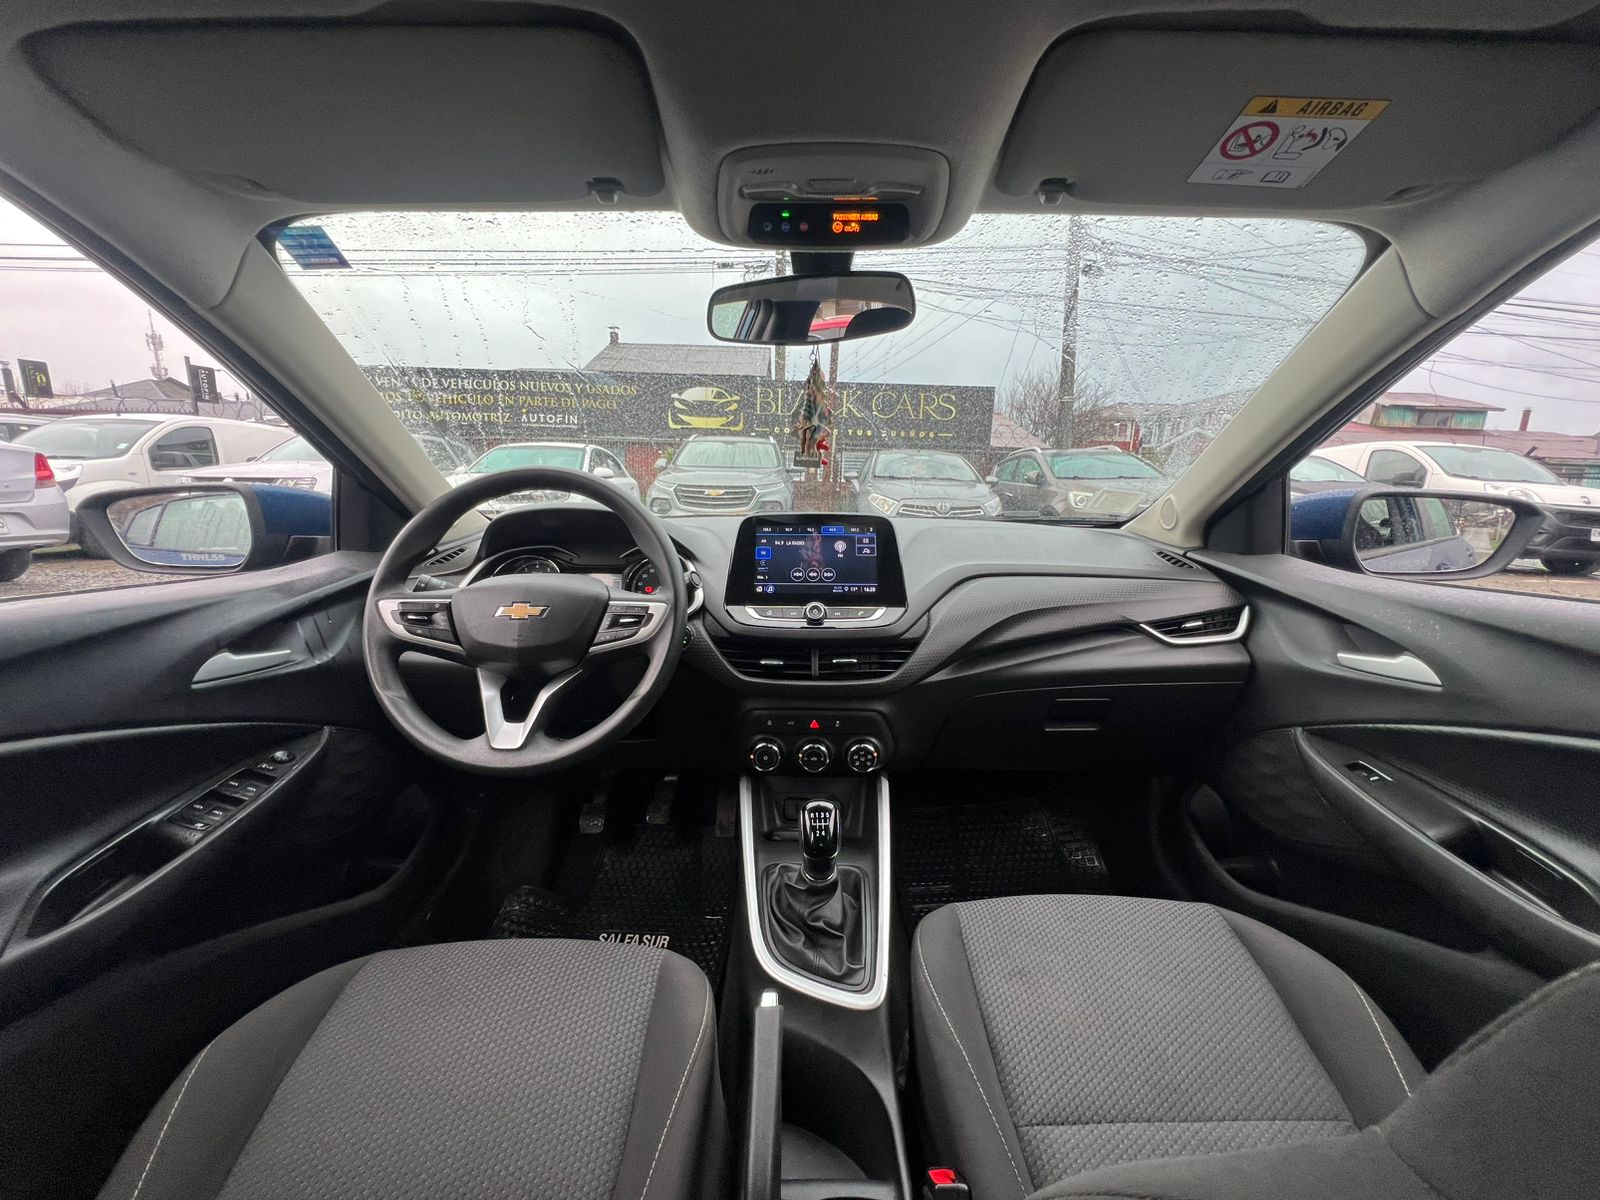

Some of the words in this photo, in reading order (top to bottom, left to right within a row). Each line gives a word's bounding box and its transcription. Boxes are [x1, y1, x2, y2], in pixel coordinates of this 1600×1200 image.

[1296, 100, 1369, 117] AIRBAG
[520, 381, 572, 394] NUEVOS
[575, 384, 584, 394] Y
[586, 384, 637, 396] USADOS
[519, 396, 558, 409] PARTE
[582, 399, 618, 410] PAGO
[754, 386, 863, 417] BLK
[872, 391, 957, 421] CARS
[521, 413, 578, 425] AUTOFIN
